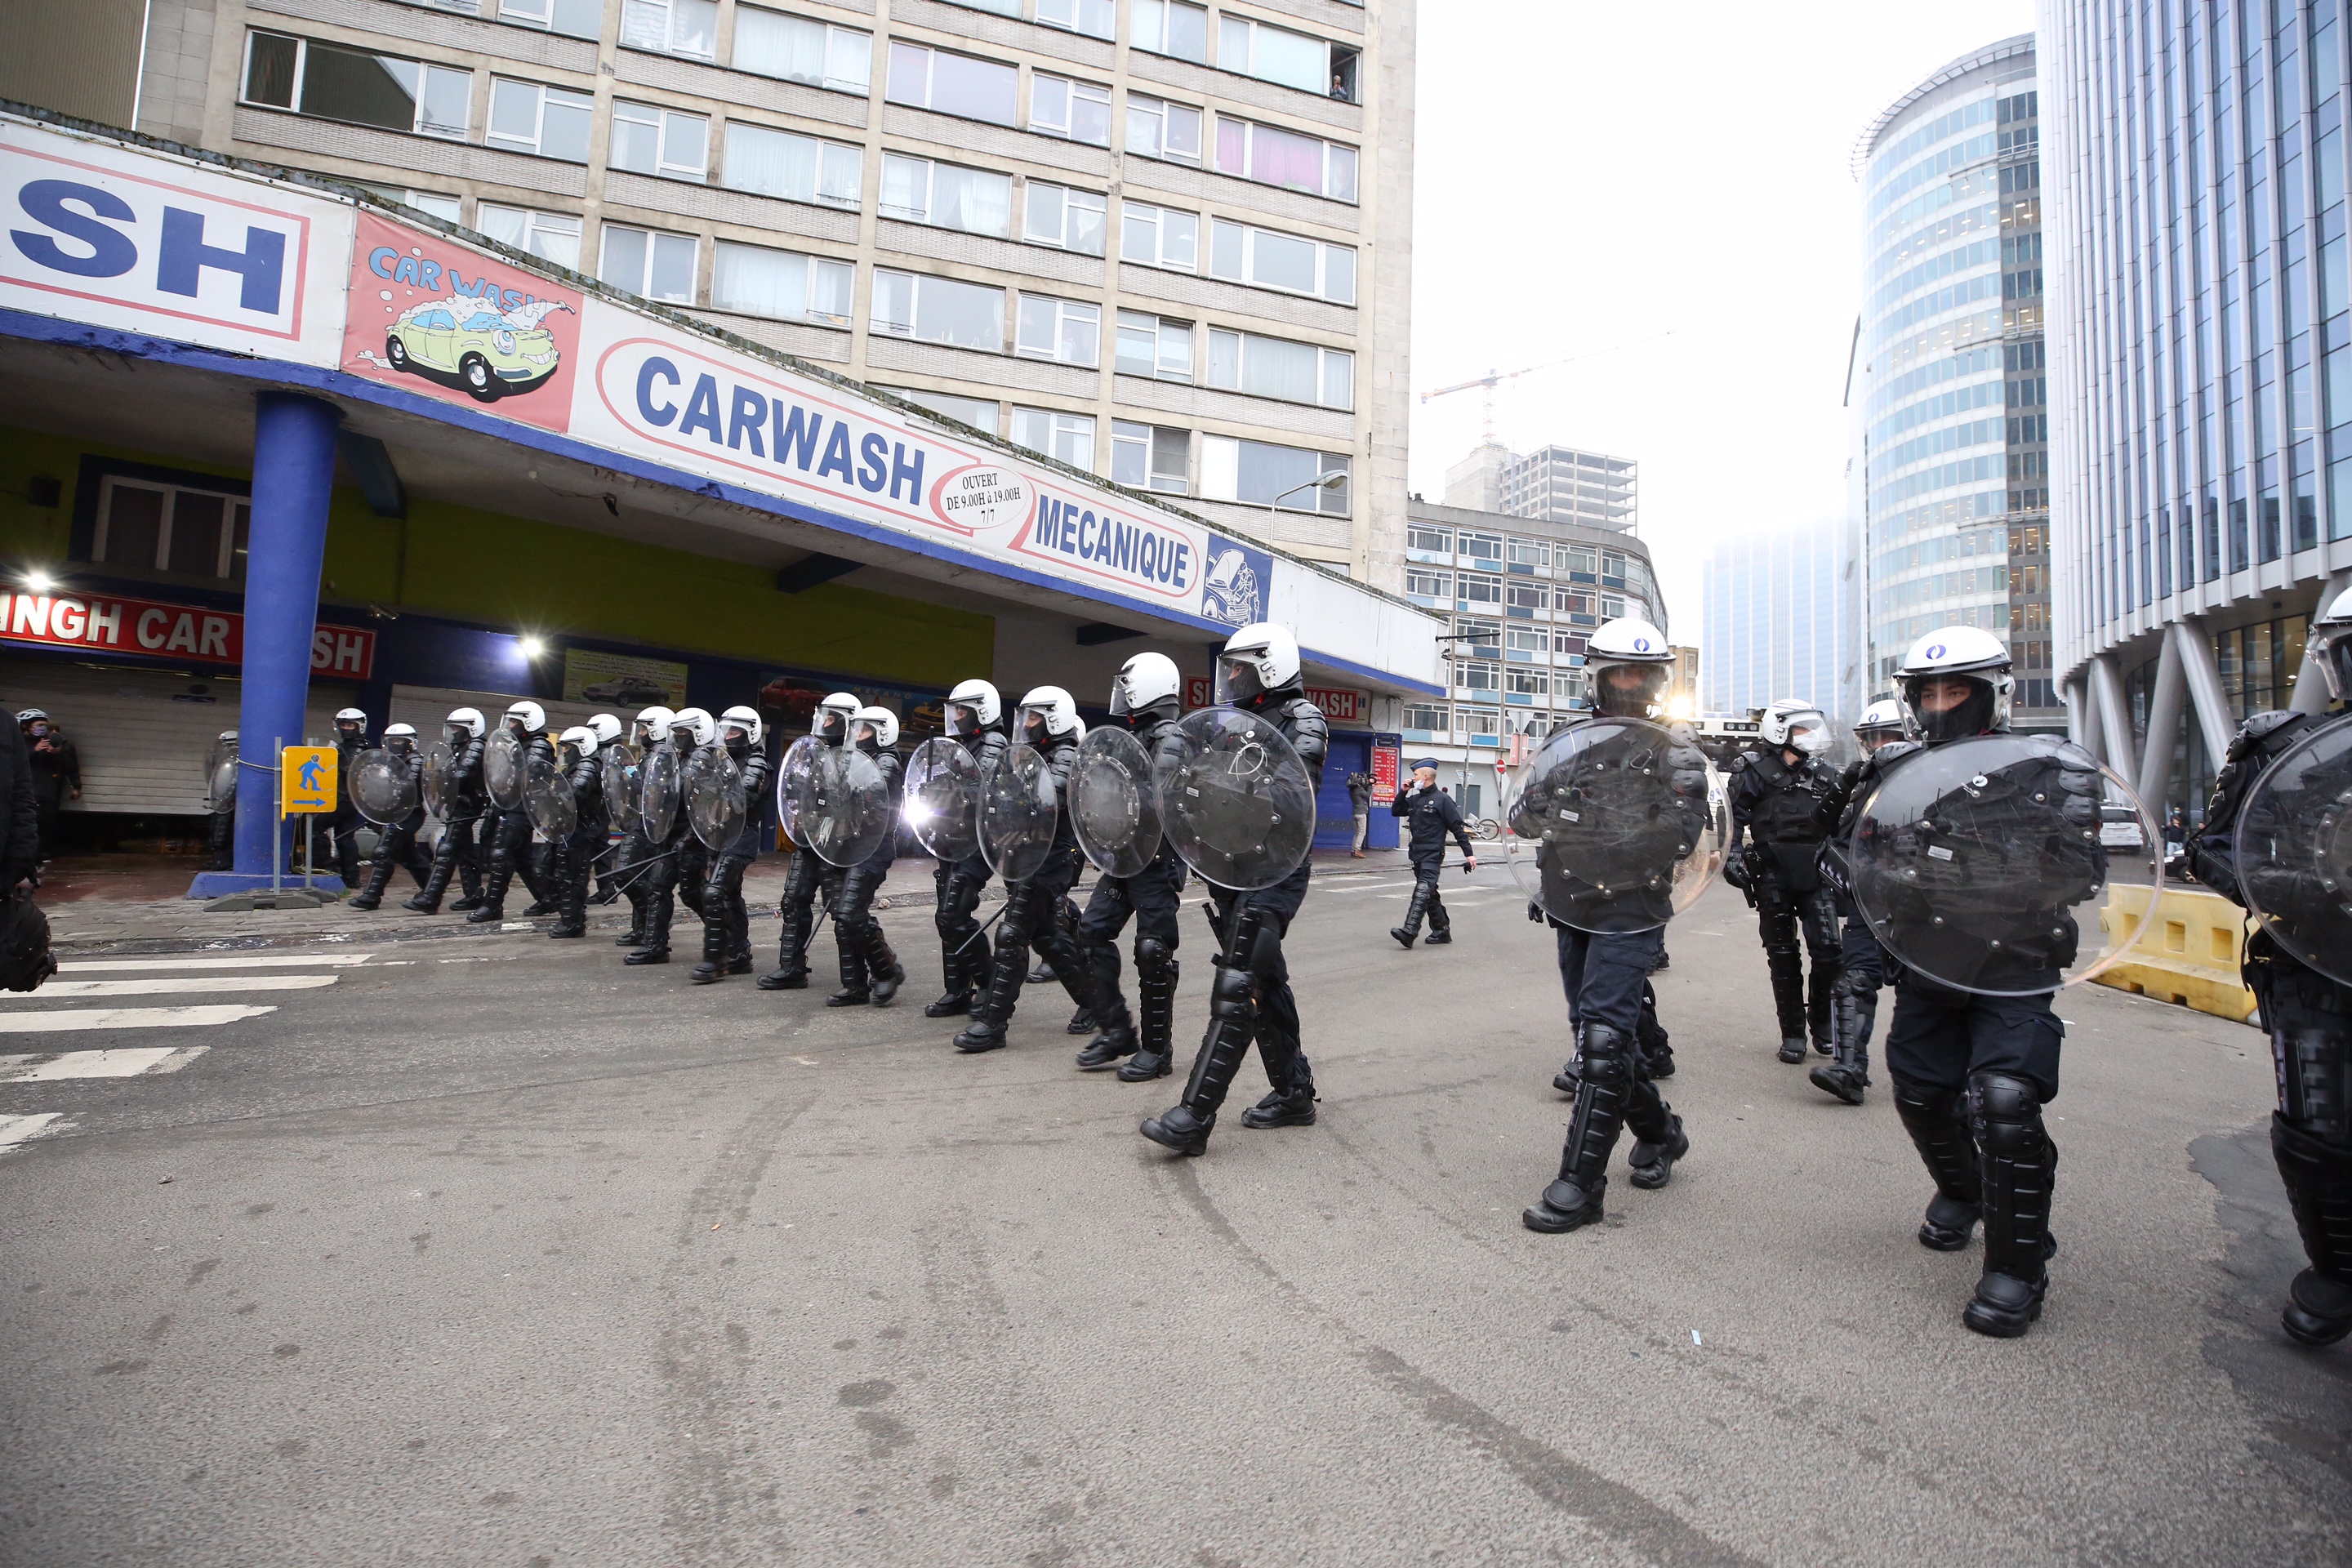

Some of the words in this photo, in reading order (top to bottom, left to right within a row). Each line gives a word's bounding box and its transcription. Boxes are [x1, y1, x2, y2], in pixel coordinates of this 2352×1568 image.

[368, 247, 442, 292] CAR
[449, 269, 547, 323] WASH
[636, 356, 925, 506] CARWASH
[947, 496, 960, 510] DE
[961, 492, 986, 509] 9.00H
[987, 490, 992, 505] à
[994, 487, 1021, 503] 19.00H
[962, 473, 998, 490] OUVERT
[981, 507, 995, 524] 7/7
[1036, 494, 1189, 589] MECANIQUE
[136, 608, 229, 657] CAR
